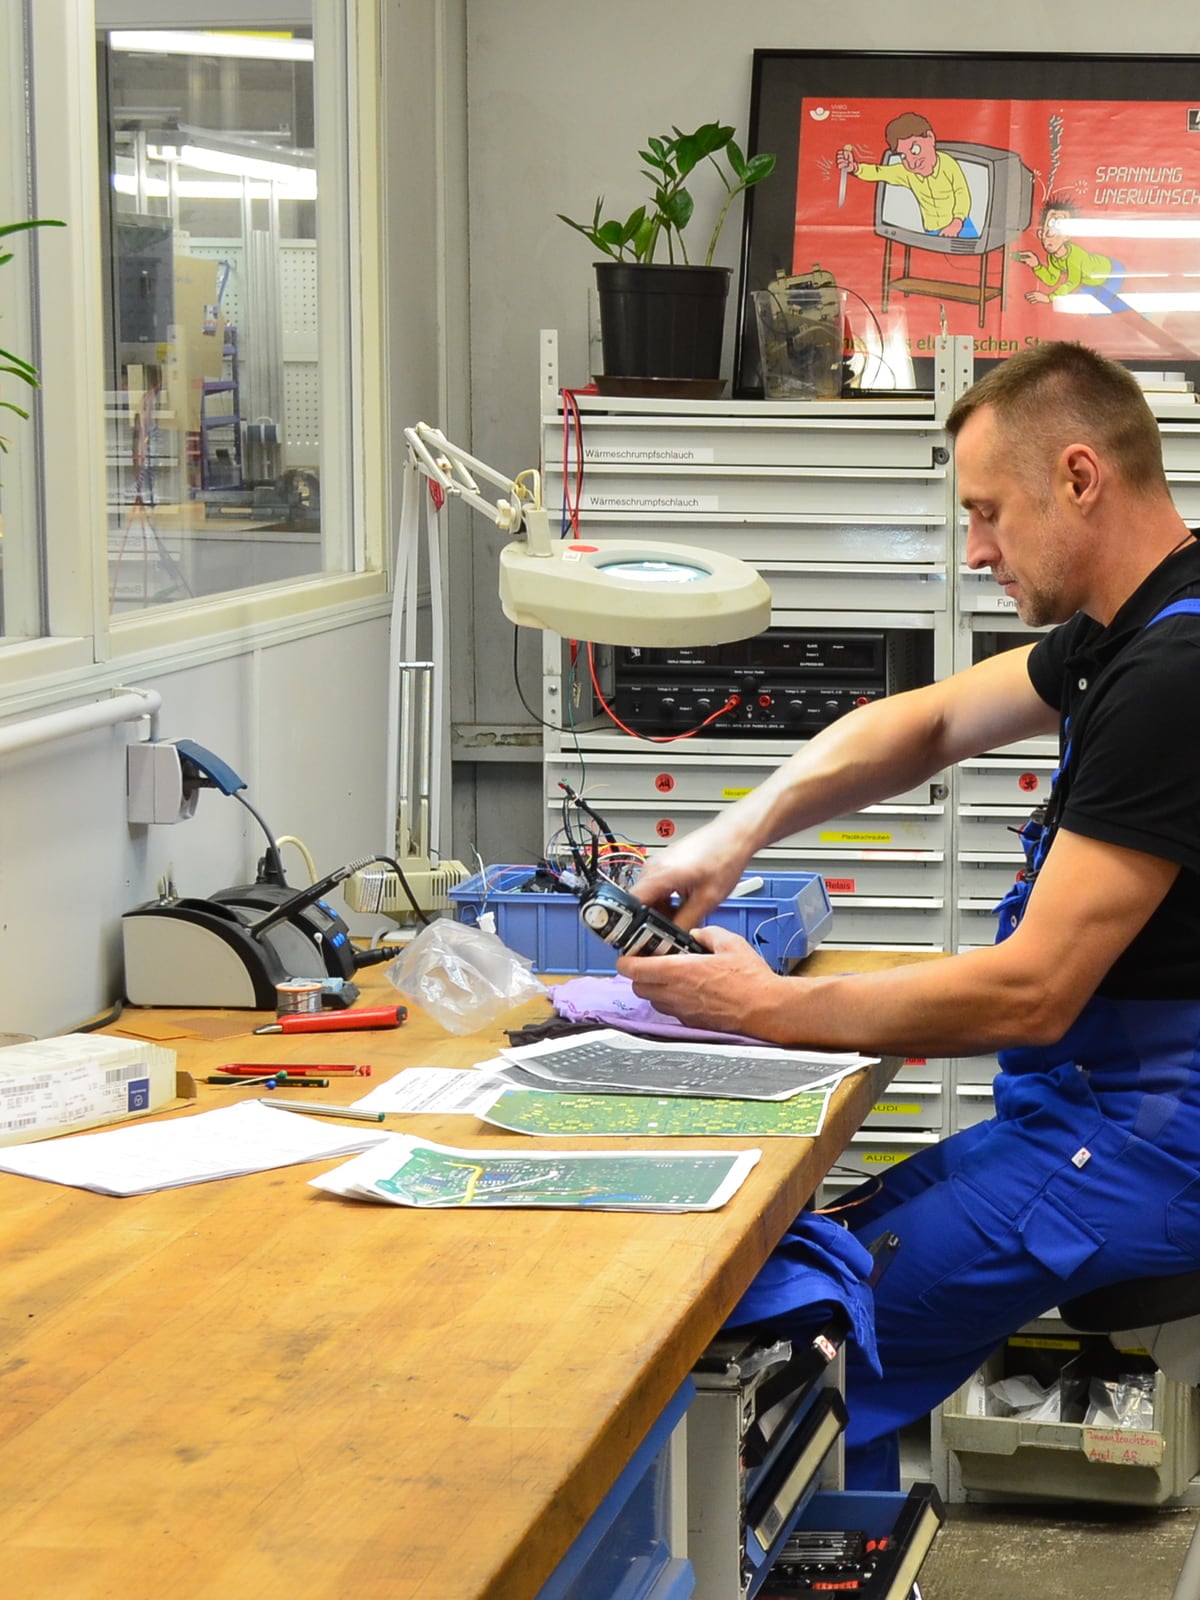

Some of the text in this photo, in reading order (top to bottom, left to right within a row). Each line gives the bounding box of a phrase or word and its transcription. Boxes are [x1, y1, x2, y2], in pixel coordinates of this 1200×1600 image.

[1095, 166, 1184, 183] SPANNUNG
[585, 448, 694, 460] Wärmeschrumpfschlauch
[590, 496, 699, 508] Wärmeschrumpfschlauch
[825, 880, 851, 890] Relais
[865, 1153, 896, 1162] AUDI
